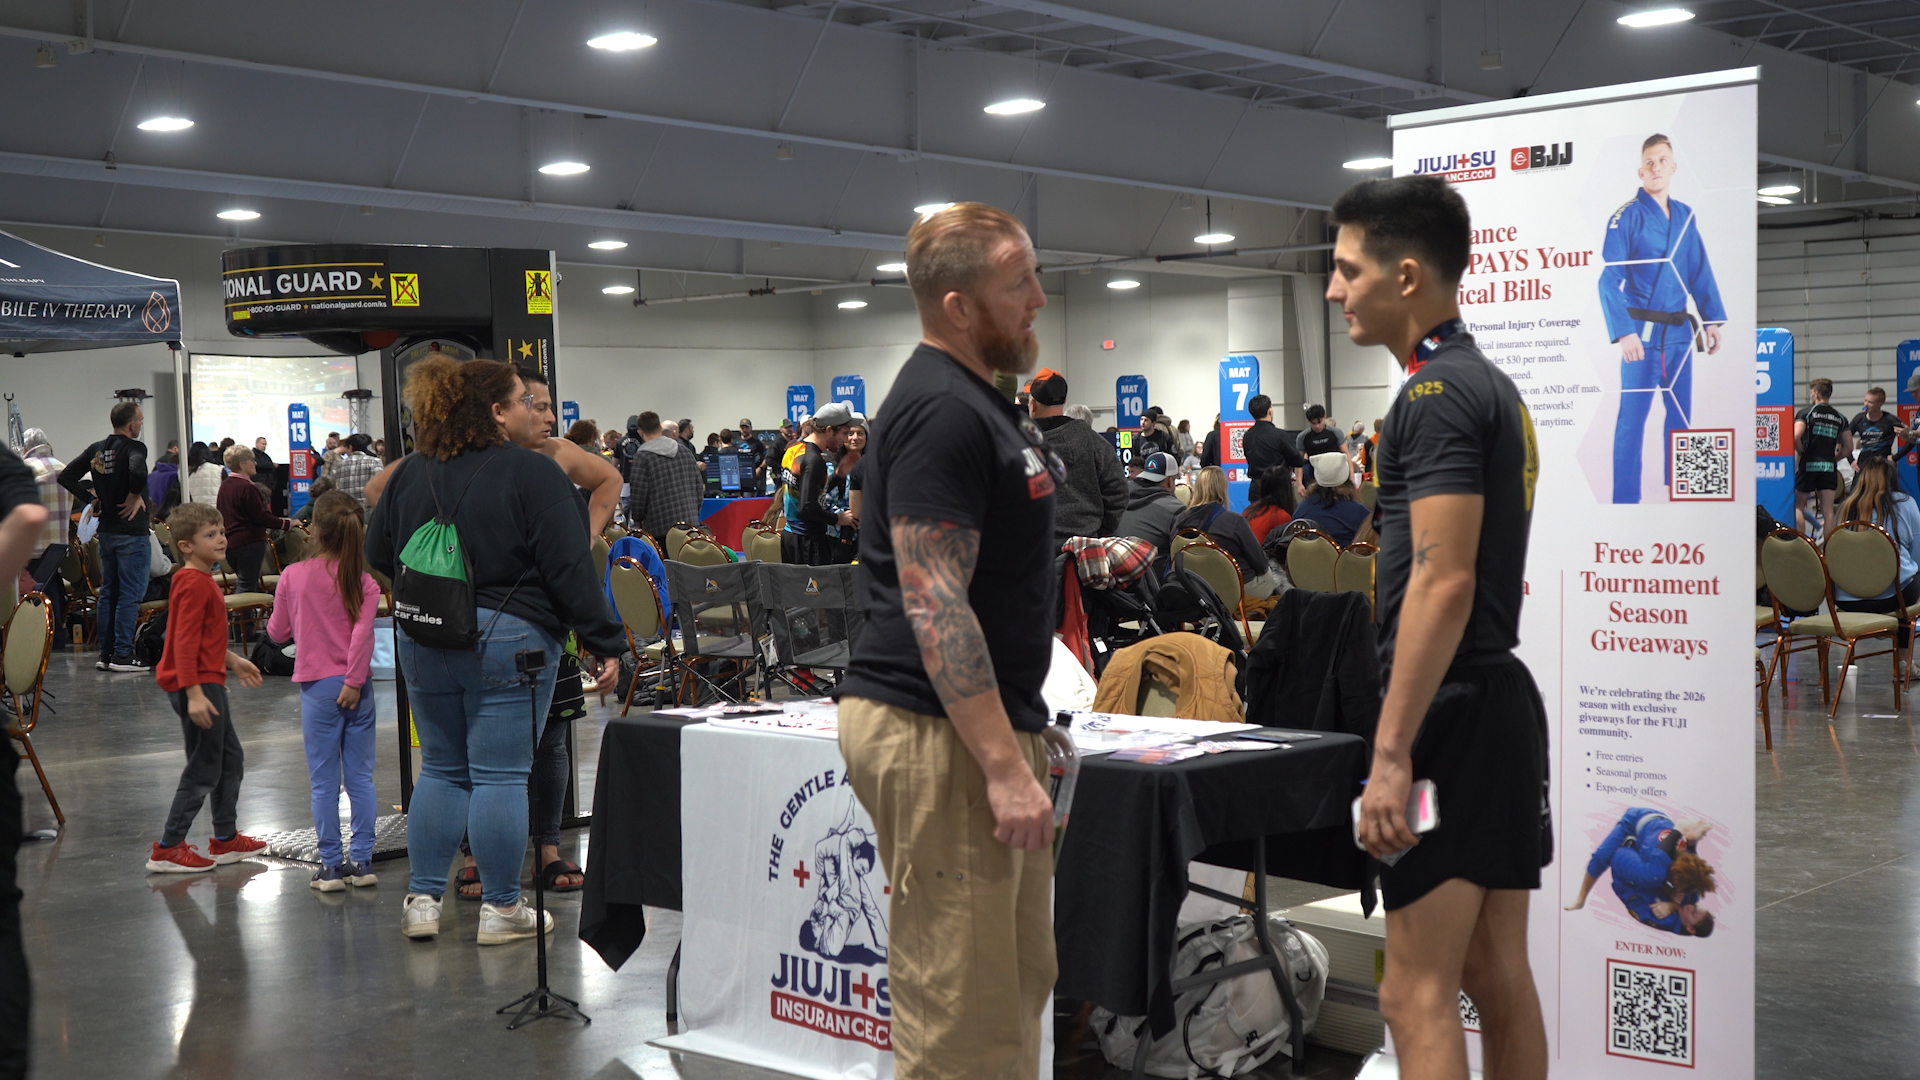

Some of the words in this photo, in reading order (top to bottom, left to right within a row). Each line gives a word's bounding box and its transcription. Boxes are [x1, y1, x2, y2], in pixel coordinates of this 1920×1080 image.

[1446, 169, 1493, 182] ANCE.COM
[1470, 226, 1518, 245] ance
[1468, 249, 1529, 275] PAYS
[1537, 247, 1594, 270] Your
[222, 275, 272, 299] TIONAL
[276, 271, 362, 294] GUARD
[1459, 282, 1496, 305] ical
[1503, 278, 1553, 302] Bills
[1, 301, 39, 317] BILE
[42, 302, 61, 318] IV
[64, 303, 136, 319] THERAPY
[311, 301, 387, 310] nationalguard.com/ks
[1469, 320, 1506, 332] Personal
[1508, 320, 1536, 331] Injury
[1538, 318, 1581, 329] Coverage
[1496, 339, 1533, 349] insurance
[1535, 337, 1572, 349] required.
[1757, 341, 1777, 354] AT
[1506, 355, 1521, 365] $30
[1523, 356, 1536, 366] per
[1538, 353, 1567, 363] month.
[1228, 367, 1251, 378] MAT
[1508, 370, 1533, 380] nteed.
[836, 386, 855, 396] MAT
[1121, 384, 1138, 394] MAT
[1408, 381, 1444, 401] 1925
[1543, 385, 1565, 395] AND
[1567, 384, 1580, 393] off
[1581, 384, 1602, 393] mats.
[793, 394, 809, 402] MAT
[1232, 383, 1249, 411] 7
[1122, 396, 1143, 416] 10
[1533, 401, 1574, 411] networks!
[291, 411, 304, 419] MAT
[1540, 417, 1576, 428] anytime.
[290, 422, 307, 442] 13
[1123, 433, 1130, 446] 0
[1123, 449, 1132, 463] 0
[1594, 542, 1644, 564] Free
[1651, 543, 1705, 565] 2026
[1580, 571, 1720, 595] Tournament
[394, 609, 411, 620] car
[412, 613, 443, 625] sales
[1609, 601, 1688, 624] Season
[1591, 629, 1708, 660] Giveaways
[1609, 688, 1663, 701] celebrating
[1665, 690, 1681, 700] the
[1683, 691, 1706, 702] 2026
[1579, 701, 1609, 710] season
[1610, 702, 1631, 711] with
[1633, 703, 1678, 714] exclusive
[1579, 713, 1625, 726] giveaways
[1626, 716, 1641, 725] for
[1643, 717, 1660, 726] the
[1662, 717, 1688, 728] FUJI
[1579, 727, 1633, 740] community.
[1596, 750, 1614, 760] Free
[1616, 753, 1644, 763] entries
[1596, 766, 1632, 778] Seasonal
[1634, 771, 1668, 781] promos
[1596, 782, 1639, 797] Expo-only
[1641, 786, 1668, 797] offers
[768, 834, 784, 883] THE
[780, 769, 835, 830] GENTLE
[841, 770, 851, 787] A
[1615, 940, 1653, 955] ENTER
[1655, 945, 1687, 959] NOW:
